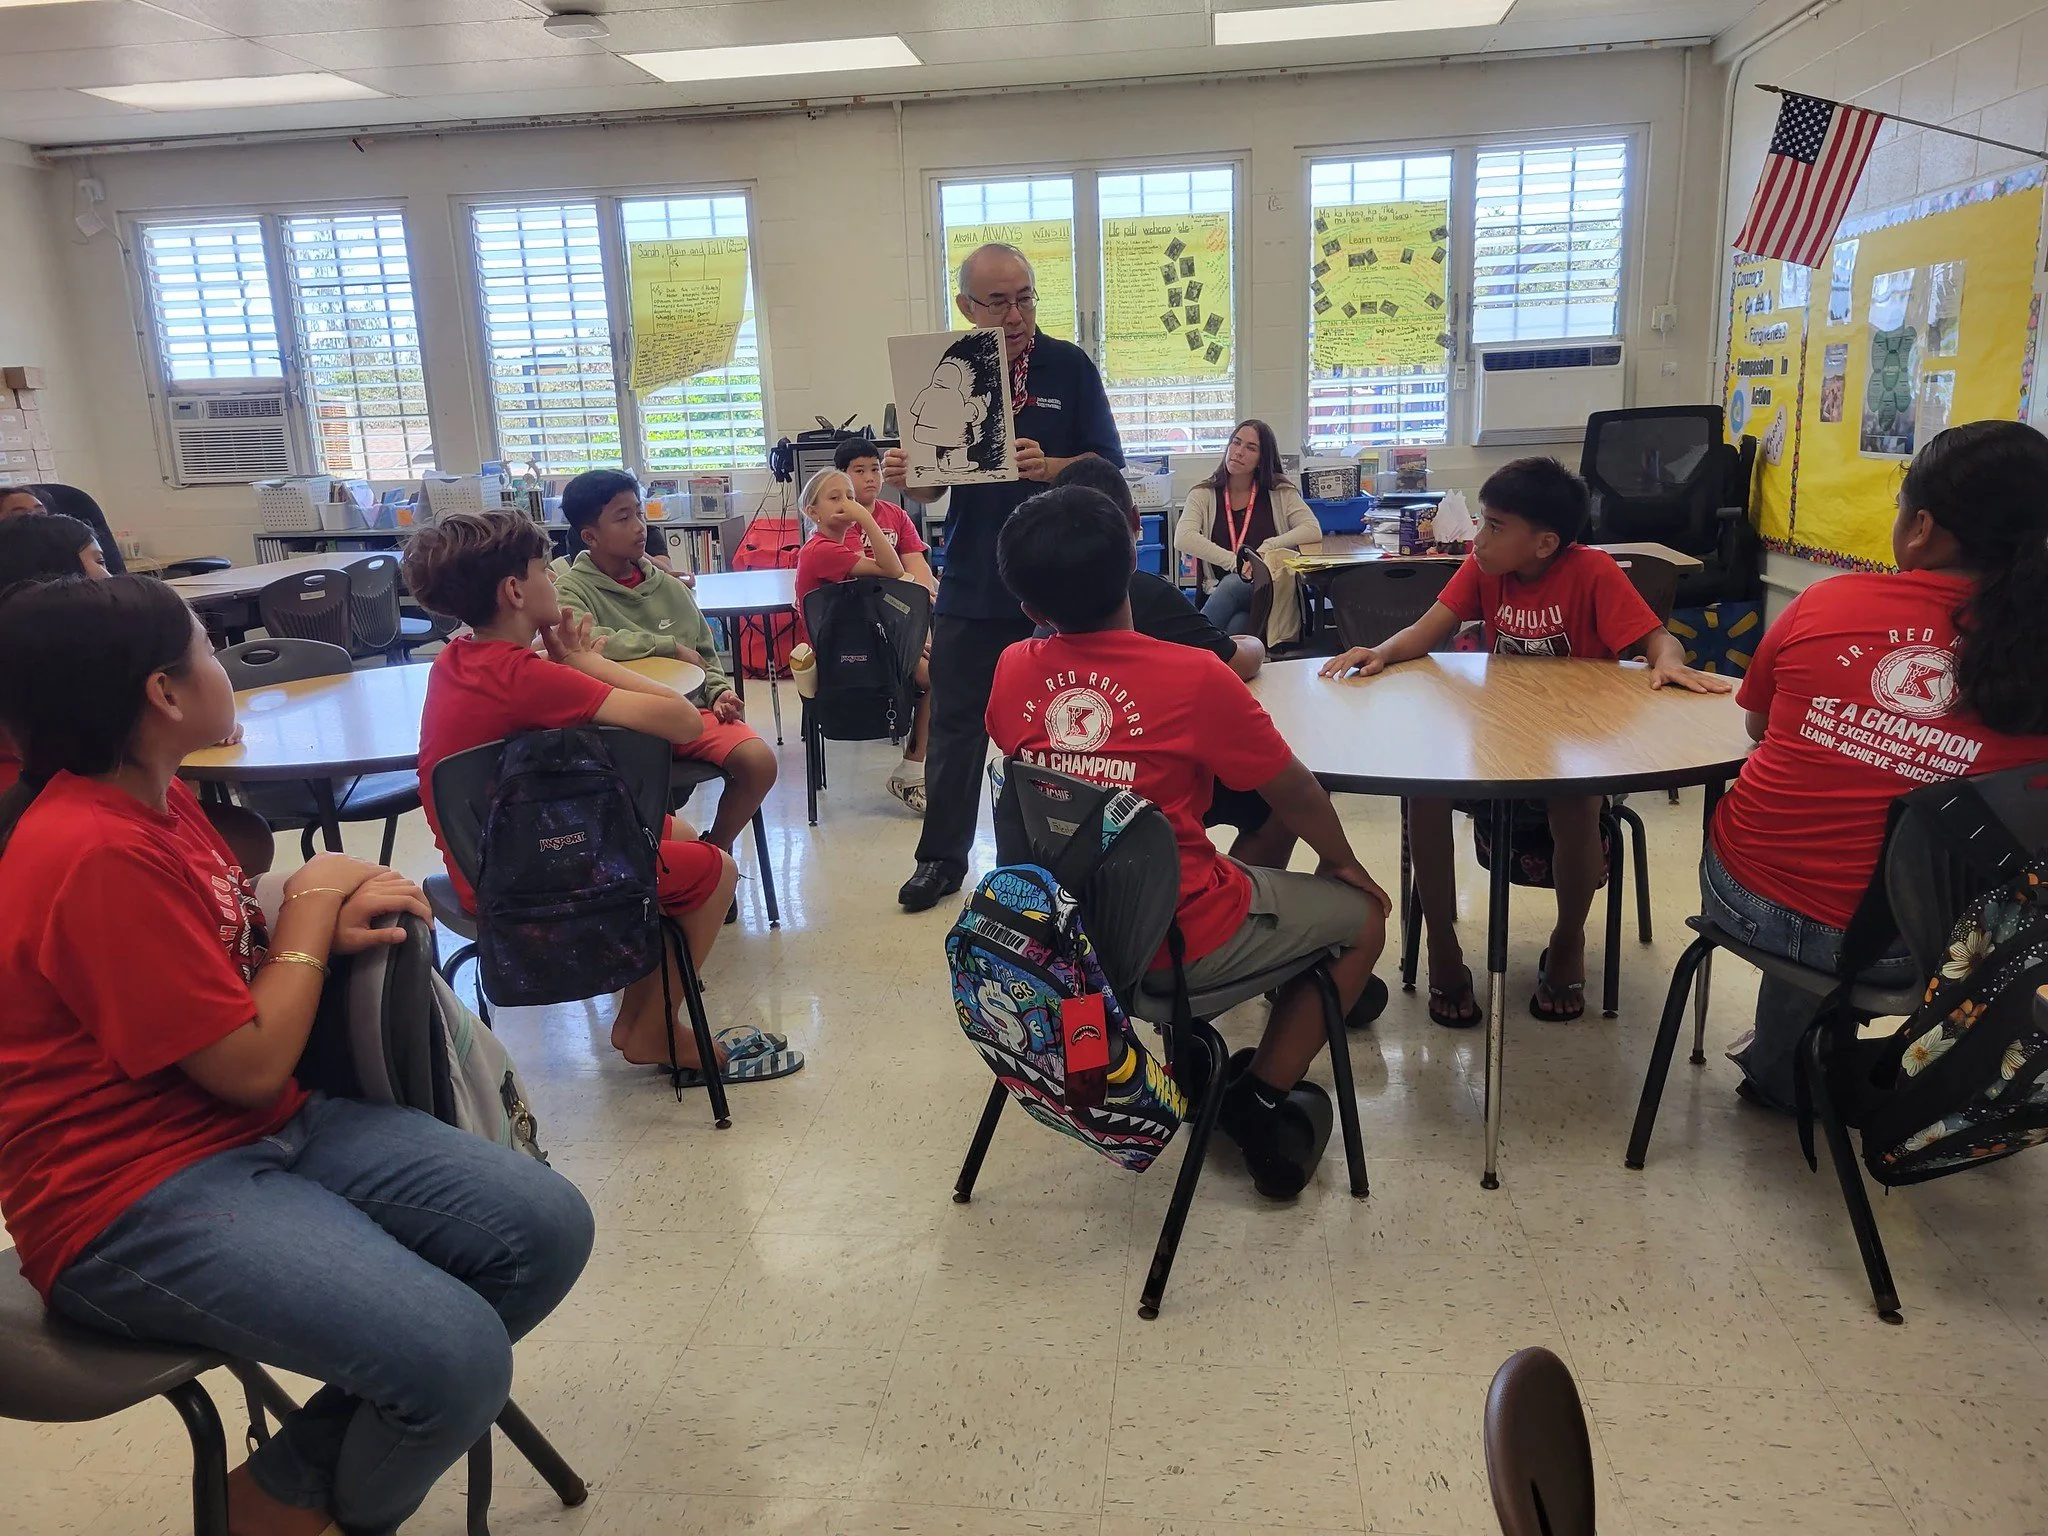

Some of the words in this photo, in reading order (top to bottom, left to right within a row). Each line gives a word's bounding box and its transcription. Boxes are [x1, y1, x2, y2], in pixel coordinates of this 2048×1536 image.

[665, 243, 687, 256] Plain
[689, 241, 705, 255] and
[982, 226, 1023, 242] ALWAYS
[1348, 232, 1372, 245] Learn
[1836, 644, 1874, 667] JR.
[1888, 627, 1934, 644] RED
[1022, 699, 1042, 723] JR.
[1045, 670, 1077, 692] RED
[1089, 671, 1144, 737] RAIDERS
[1805, 708, 1837, 731] MAKE
[1837, 721, 1916, 759] EXCELLENCE
[1914, 751, 1927, 764] A
[1928, 754, 1970, 776] HABIT
[1811, 695, 1841, 715] BE
[1842, 703, 1859, 722] A
[1861, 708, 1983, 762] CHAMPION
[1037, 751, 1047, 768] A
[1050, 753, 1137, 782] CHAMPION
[539, 831, 585, 852] JANSPORT
